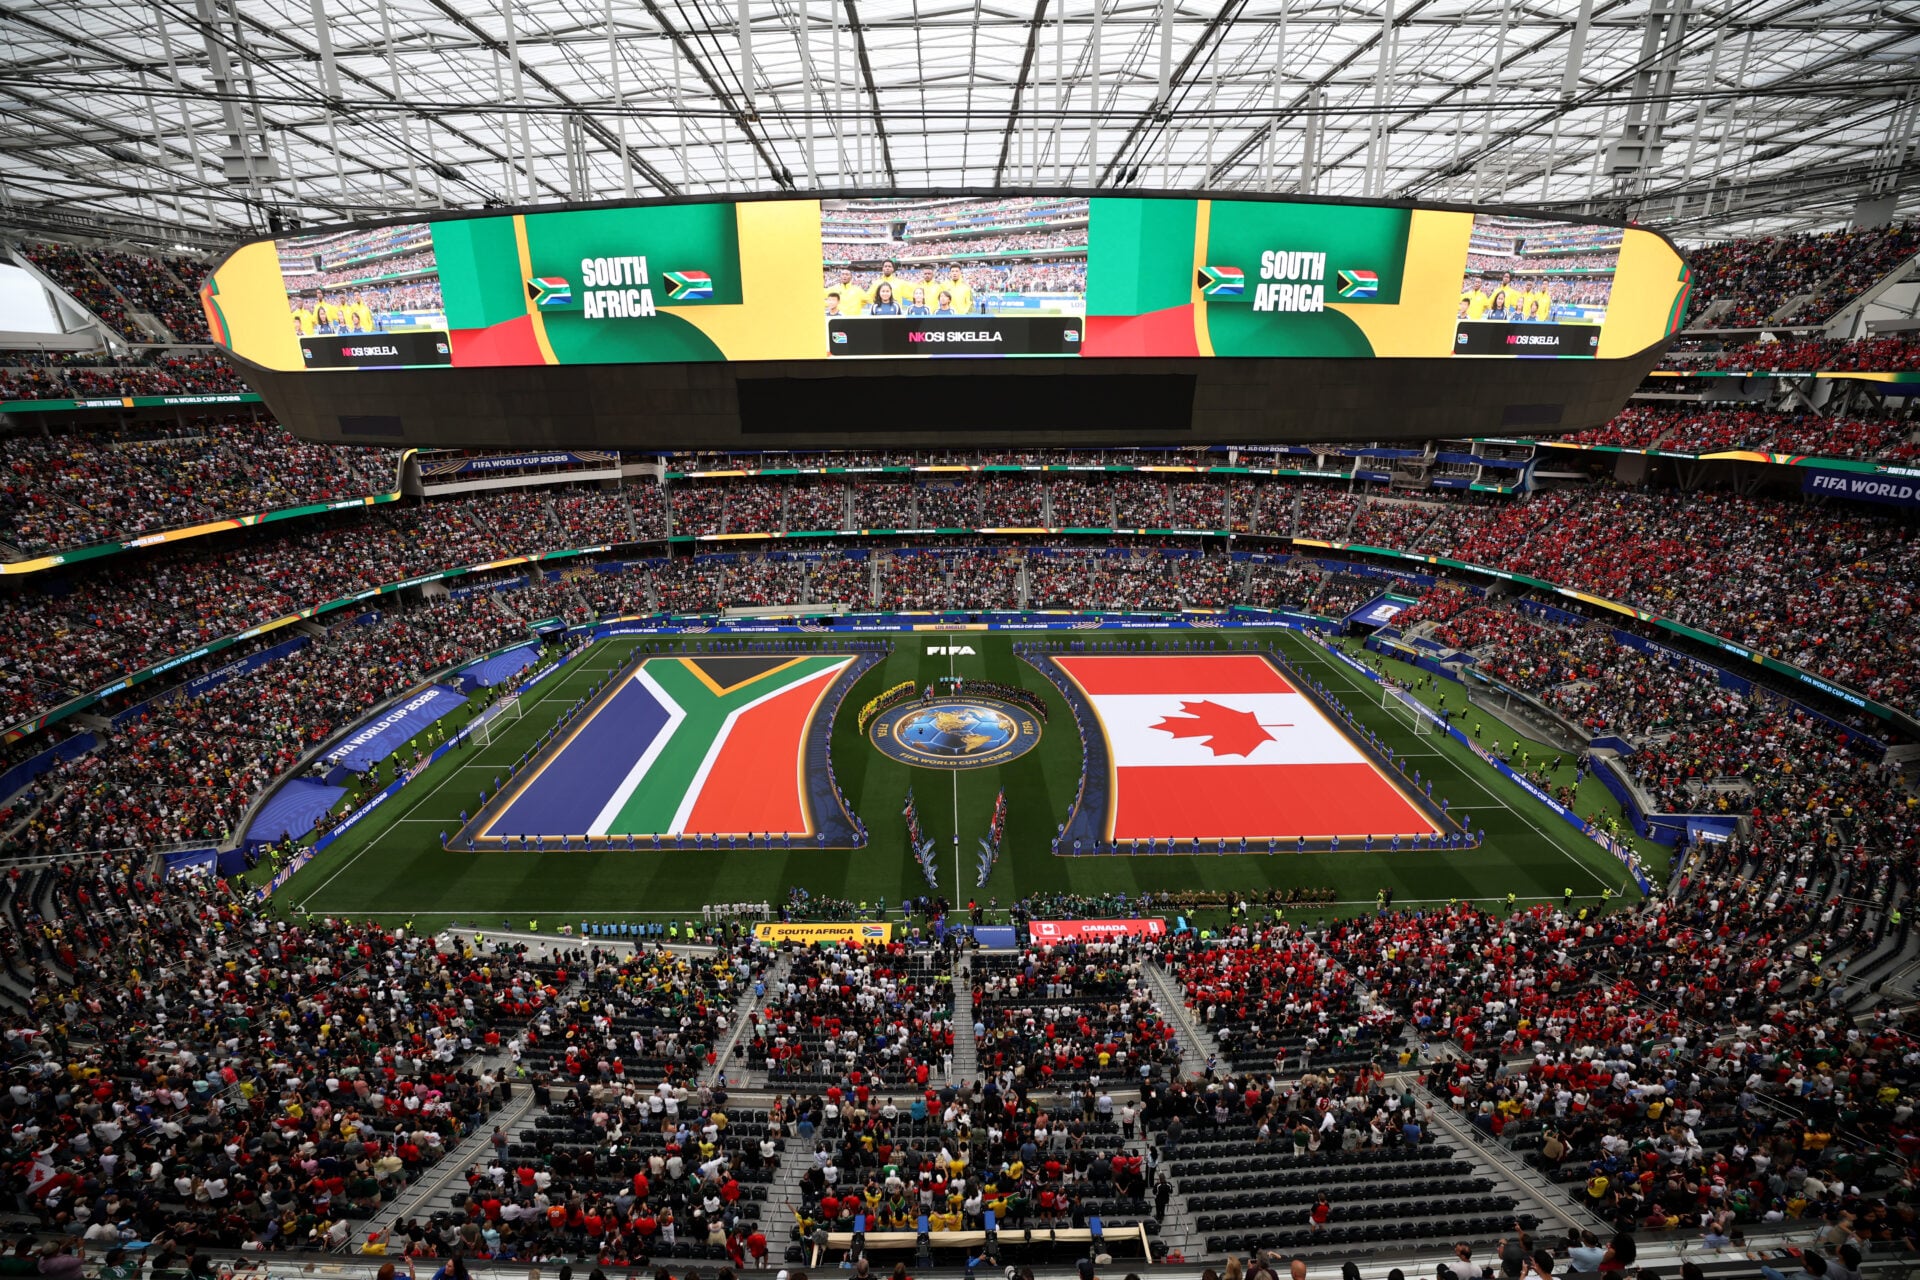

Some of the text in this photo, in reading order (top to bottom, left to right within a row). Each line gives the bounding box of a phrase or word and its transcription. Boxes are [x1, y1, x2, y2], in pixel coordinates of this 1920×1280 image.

[581, 256, 648, 287] SOUTH
[1260, 250, 1326, 280] SOUTH
[583, 288, 656, 319] AFRICA
[1253, 283, 1324, 312] AFRICA
[909, 332, 1002, 342] NKOSI SIKELELA
[1506, 335, 1559, 345] NKOSI SIKELELA
[342, 346, 398, 357] NKOSI SIKELELA
[472, 455, 569, 469] FIFA WORLD CUP 2026
[1812, 475, 1847, 491] FIFA
[1851, 480, 1913, 499] WORLD
[1382, 569, 1416, 579] ANGELES
[491, 580, 502, 588] CUP
[927, 646, 977, 656] FIFA
[1645, 641, 1659, 652] FIFA
[191, 659, 249, 687] LOS ANGELES
[1800, 674, 1866, 708] FIFA WORLD CUP 2026
[328, 689, 440, 763] FIFA WORLD CUP 2026
[877, 722, 889, 738] FIFA
[1022, 720, 1034, 735] FIFA
[899, 752, 919, 762] FIFA
[920, 758, 957, 766] WORLD
[981, 750, 1012, 763] 2026
[1511, 773, 1565, 815] FIFA WORLD CUP 2026
[334, 792, 388, 837] FIFA WORLD CUP 2026
[1082, 924, 1128, 932] CANADA
